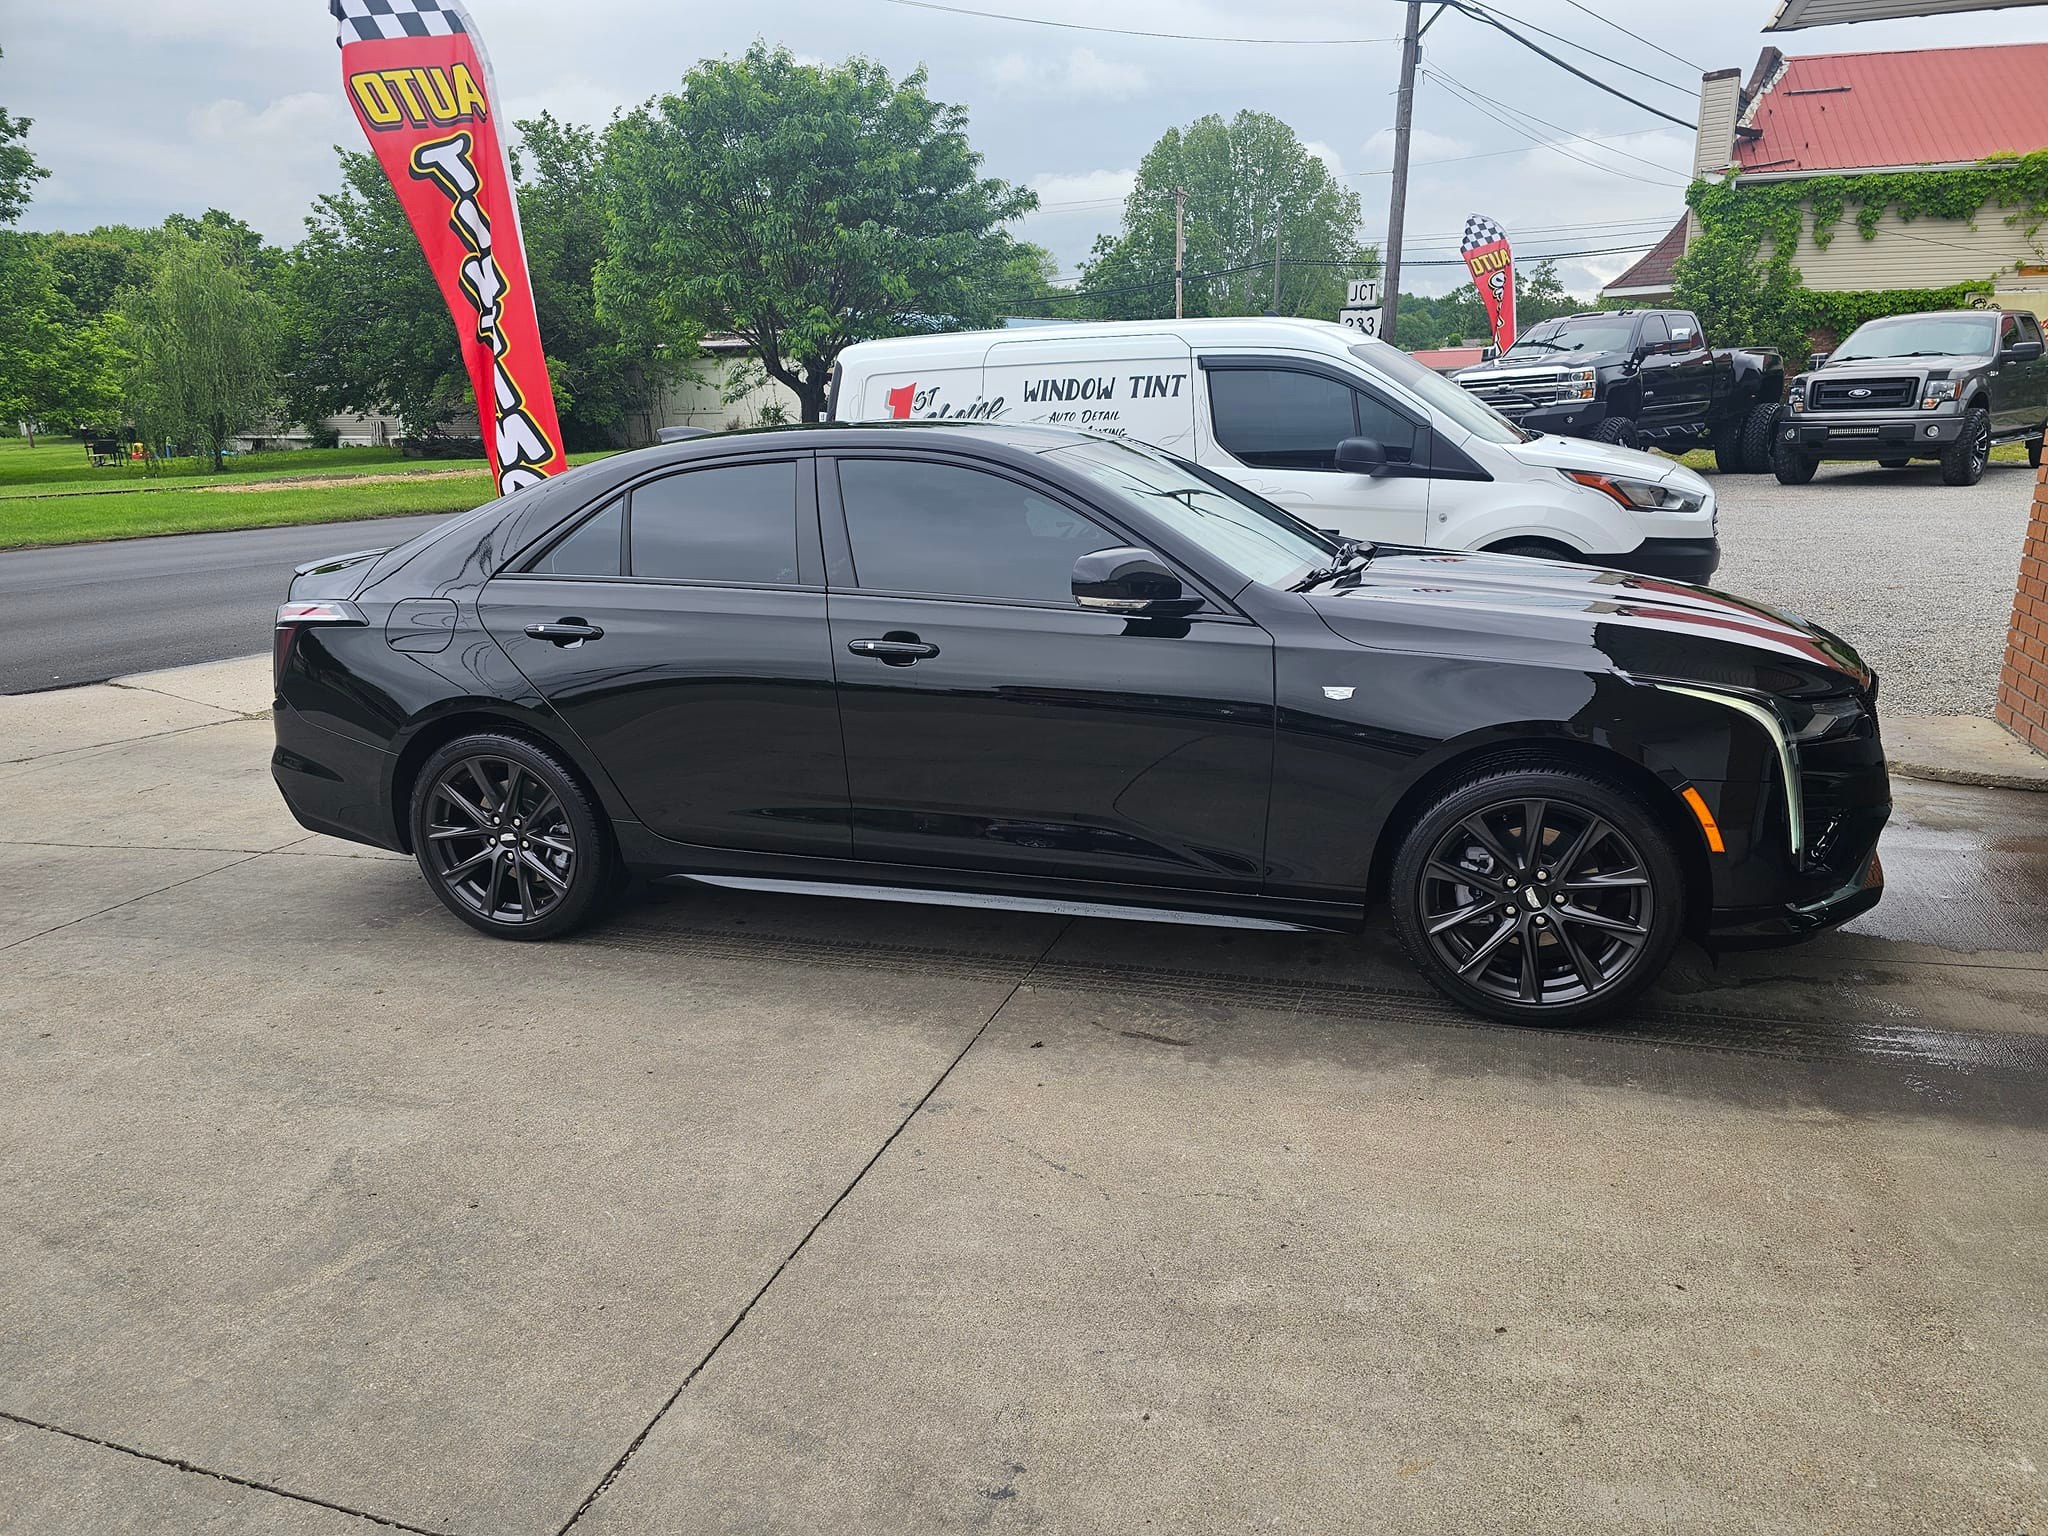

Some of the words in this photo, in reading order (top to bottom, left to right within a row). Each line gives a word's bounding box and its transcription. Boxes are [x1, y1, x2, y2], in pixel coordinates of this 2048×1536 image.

[1350, 283, 1376, 302] JCT
[1024, 376, 1116, 402] WINDOW
[1129, 374, 1187, 399] TINT
[1048, 411, 1077, 423] AUTO
[1081, 409, 1120, 423] DETAIL
